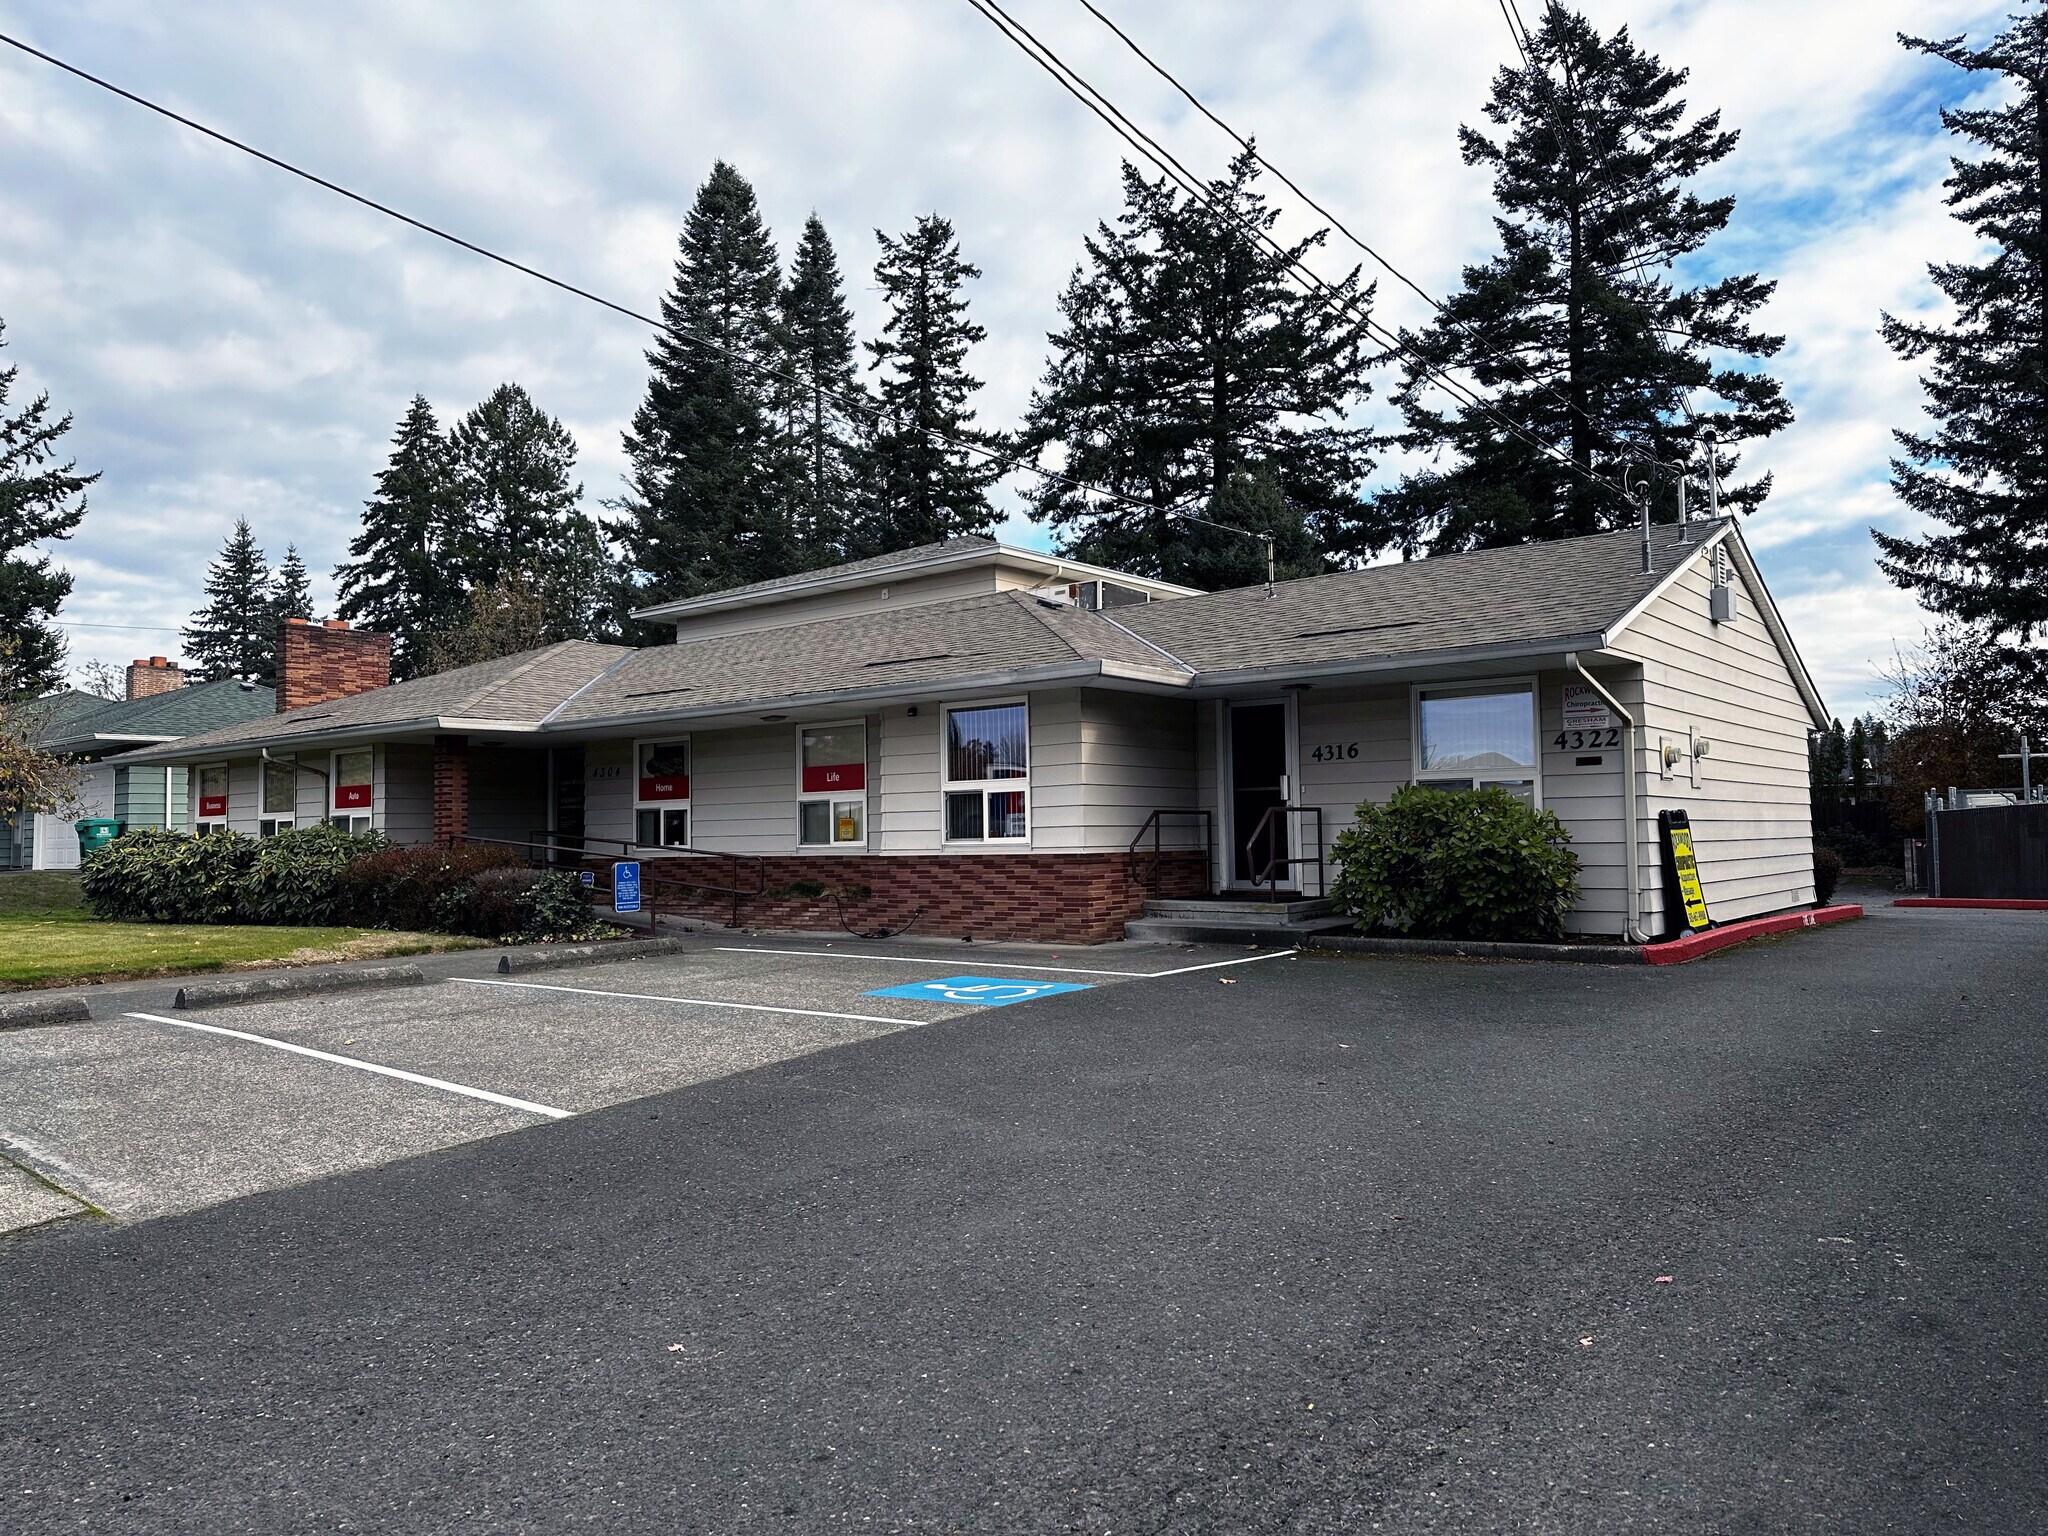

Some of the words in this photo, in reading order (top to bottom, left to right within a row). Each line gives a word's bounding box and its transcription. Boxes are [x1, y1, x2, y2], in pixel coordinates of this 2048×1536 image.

[1553, 728, 1619, 750] 4322
[1311, 742, 1359, 762] 4316
[593, 766, 621, 778] 4304
[826, 772, 840, 782] Life
[655, 783, 673, 792] Home
[348, 791, 360, 800] Auto
